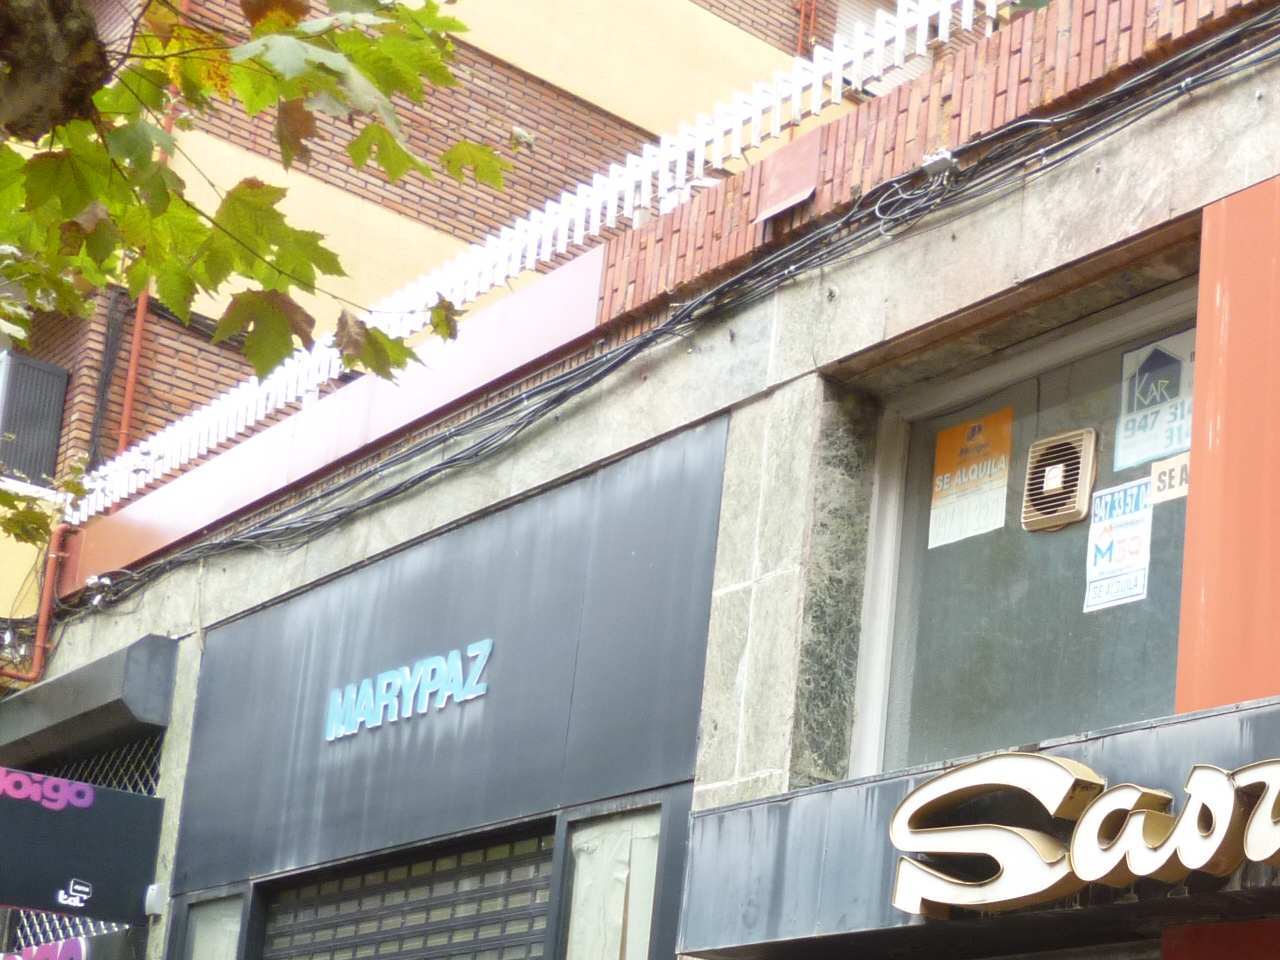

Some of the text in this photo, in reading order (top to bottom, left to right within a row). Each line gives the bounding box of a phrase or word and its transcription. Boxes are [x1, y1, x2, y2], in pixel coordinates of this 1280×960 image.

[1123, 398, 1192, 440] 947 31
[936, 455, 1009, 491] SE ALQUILA
[1157, 468, 1176, 493] SE
[325, 638, 493, 742] MARYPAZ
[0, 766, 96, 812] oigo
